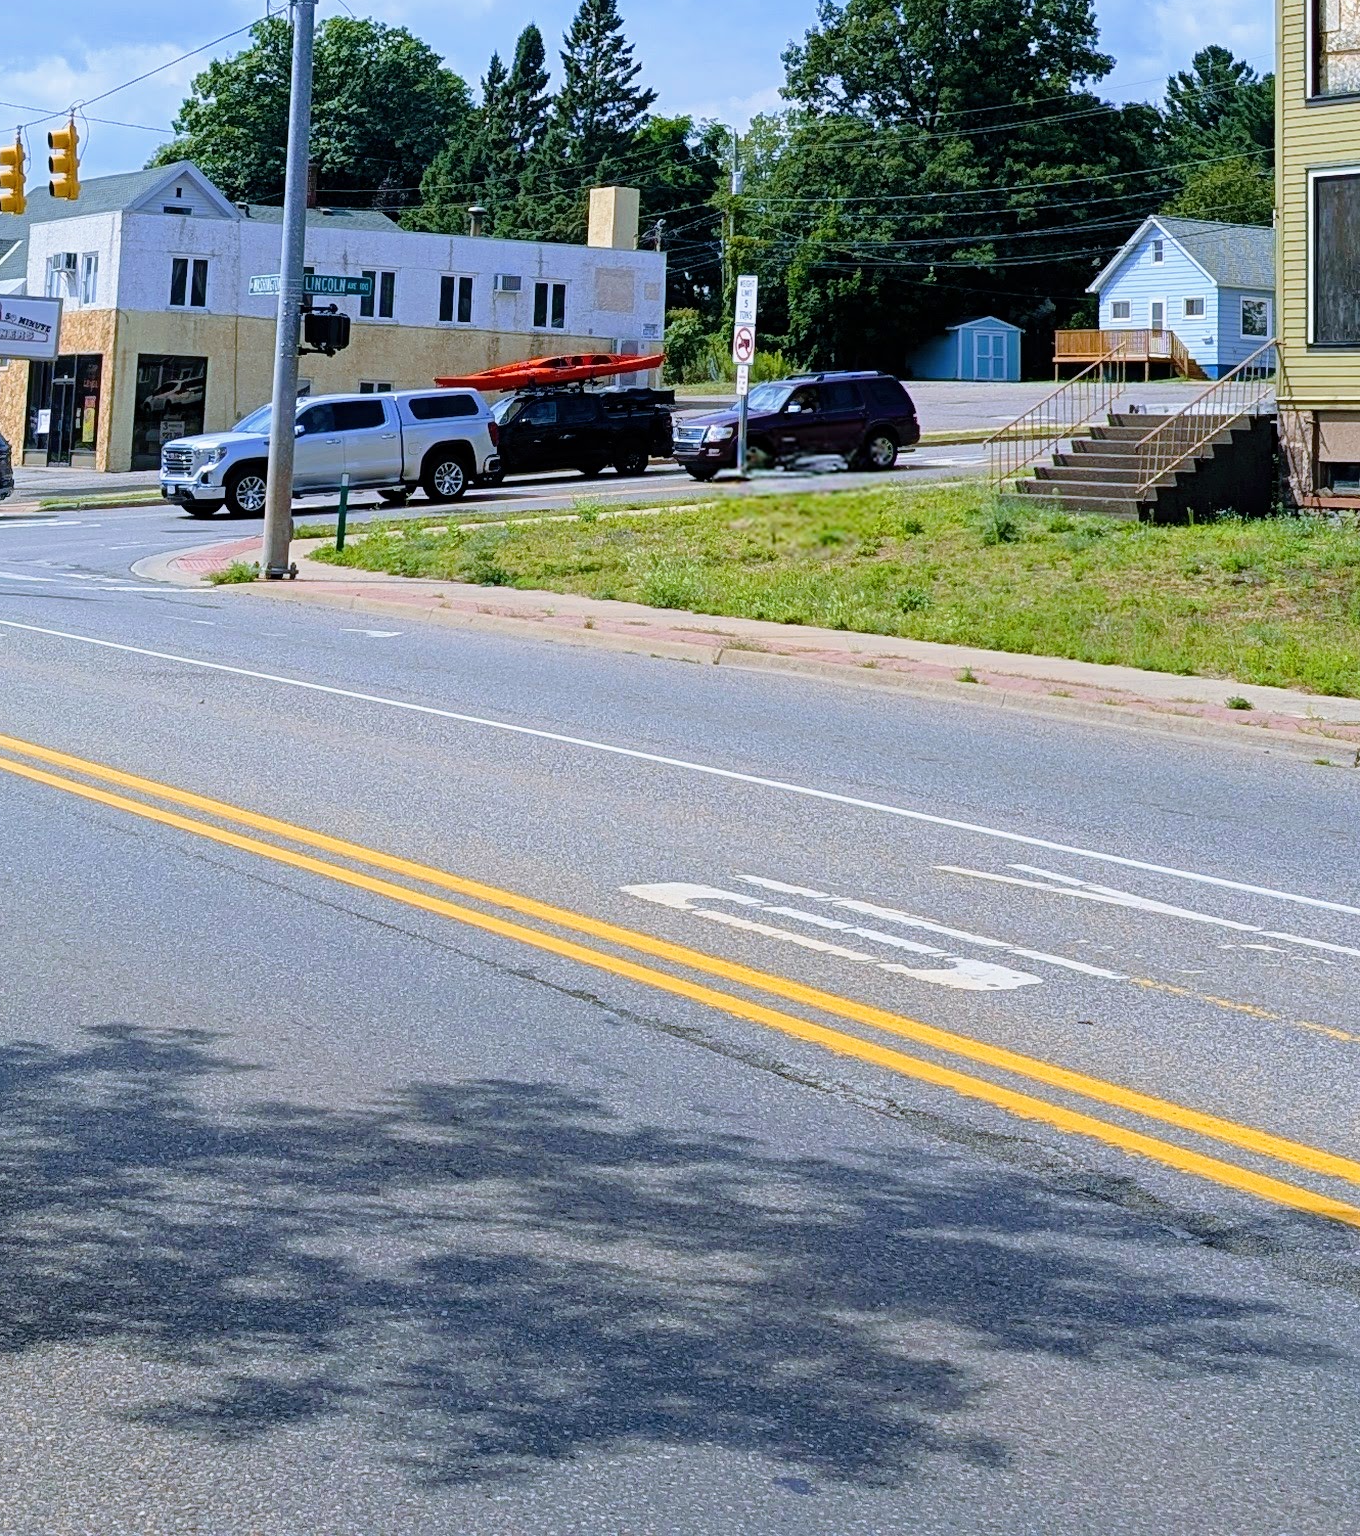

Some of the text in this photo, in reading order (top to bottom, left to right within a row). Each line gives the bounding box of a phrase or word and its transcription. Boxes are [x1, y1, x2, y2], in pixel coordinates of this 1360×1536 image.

[305, 276, 347, 292] LINCOLN
[744, 300, 749, 308] 5
[18, 316, 52, 333] MINUTE
